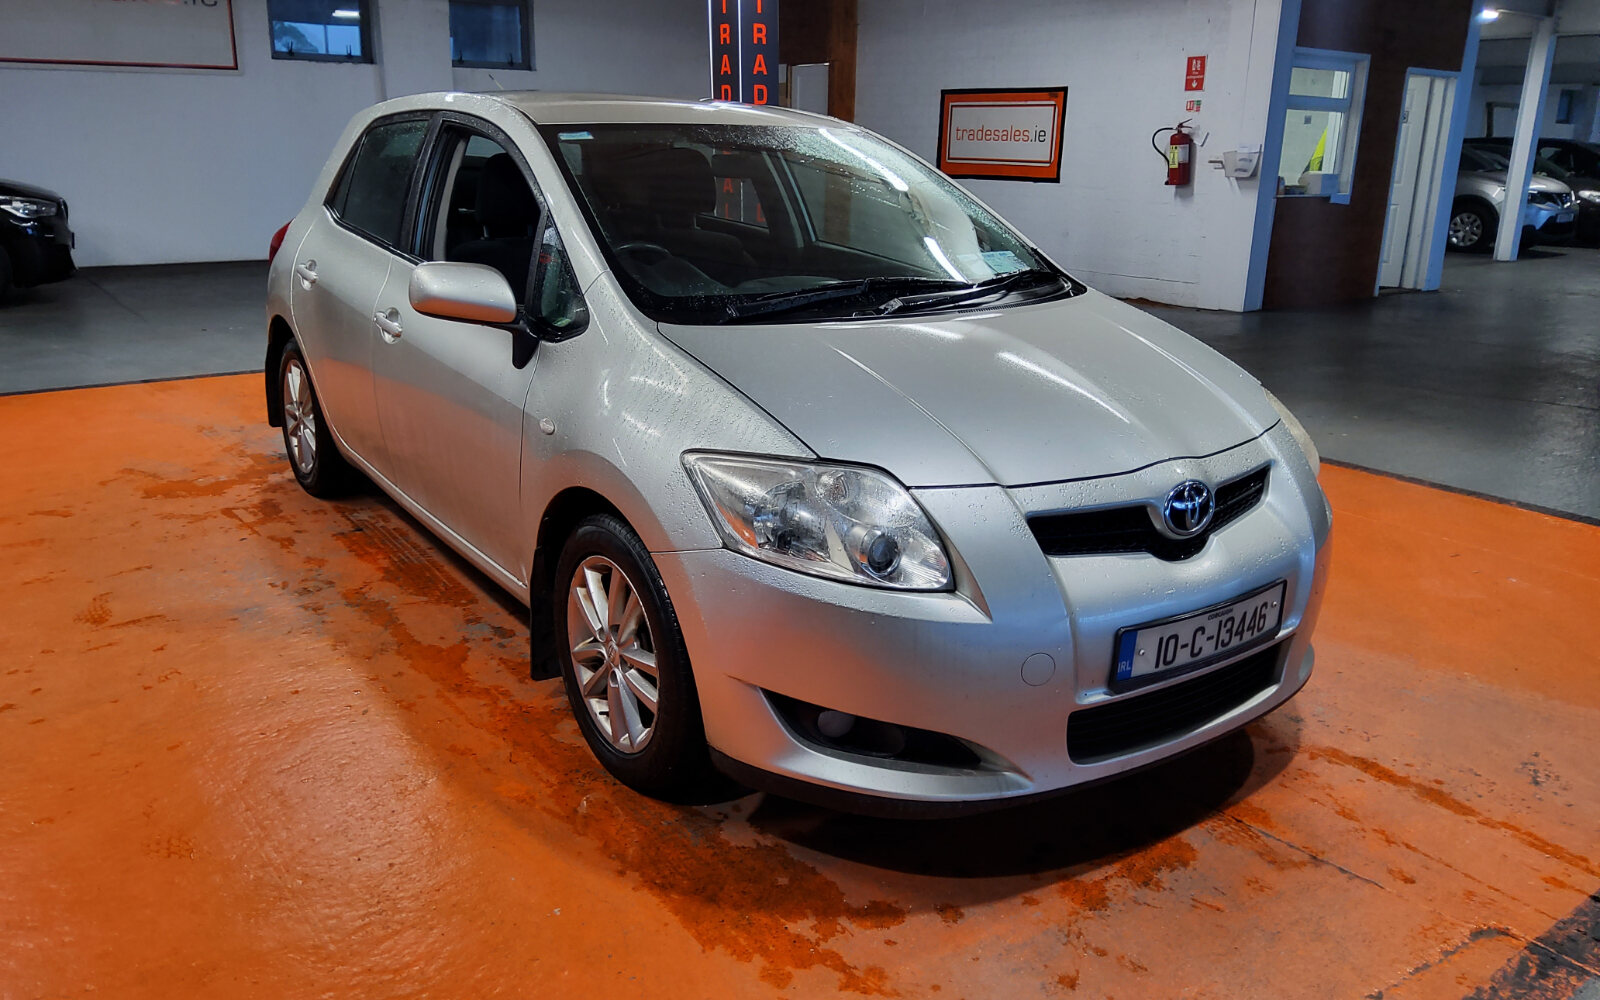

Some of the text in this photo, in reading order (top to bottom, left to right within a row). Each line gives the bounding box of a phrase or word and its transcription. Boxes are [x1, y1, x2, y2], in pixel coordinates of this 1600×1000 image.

[955, 124, 1047, 143] tradesales.ie
[1154, 601, 1268, 669] 10-C-13446
[1117, 661, 1132, 673] IRL
